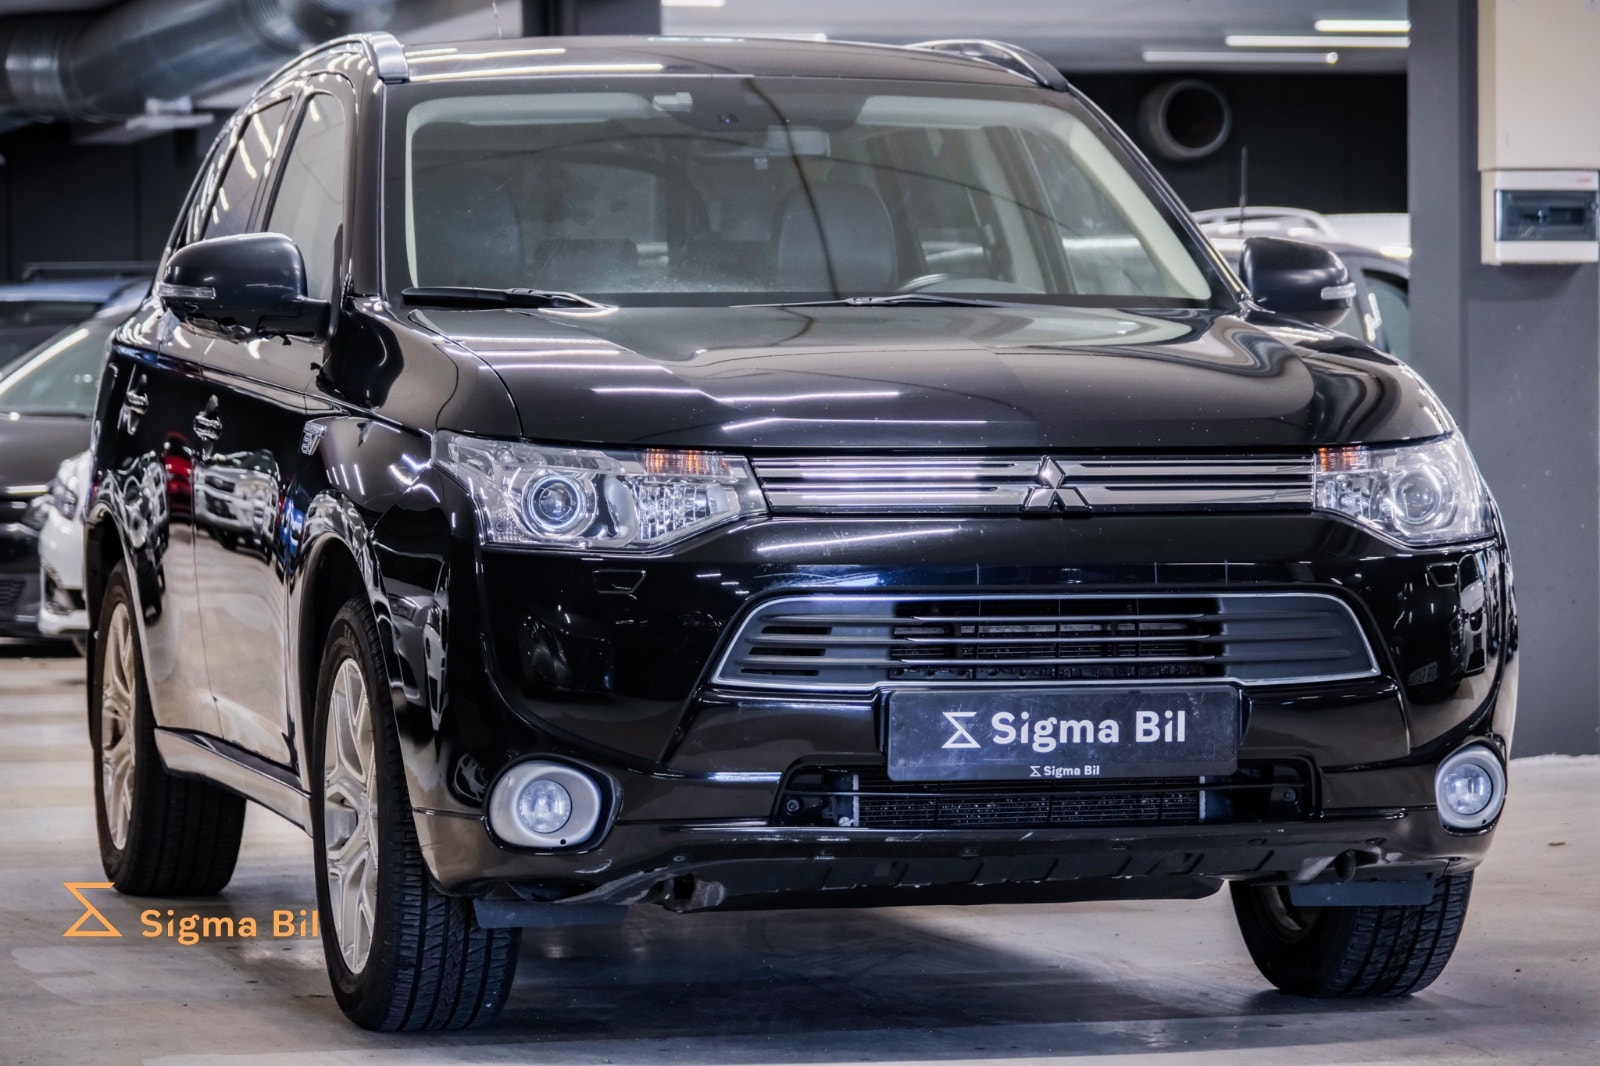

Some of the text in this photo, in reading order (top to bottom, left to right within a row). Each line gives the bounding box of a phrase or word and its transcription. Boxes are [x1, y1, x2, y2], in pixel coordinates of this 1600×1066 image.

[991, 710, 1186, 753] Sigma Bil
[1043, 765, 1100, 778] Sigma Bil
